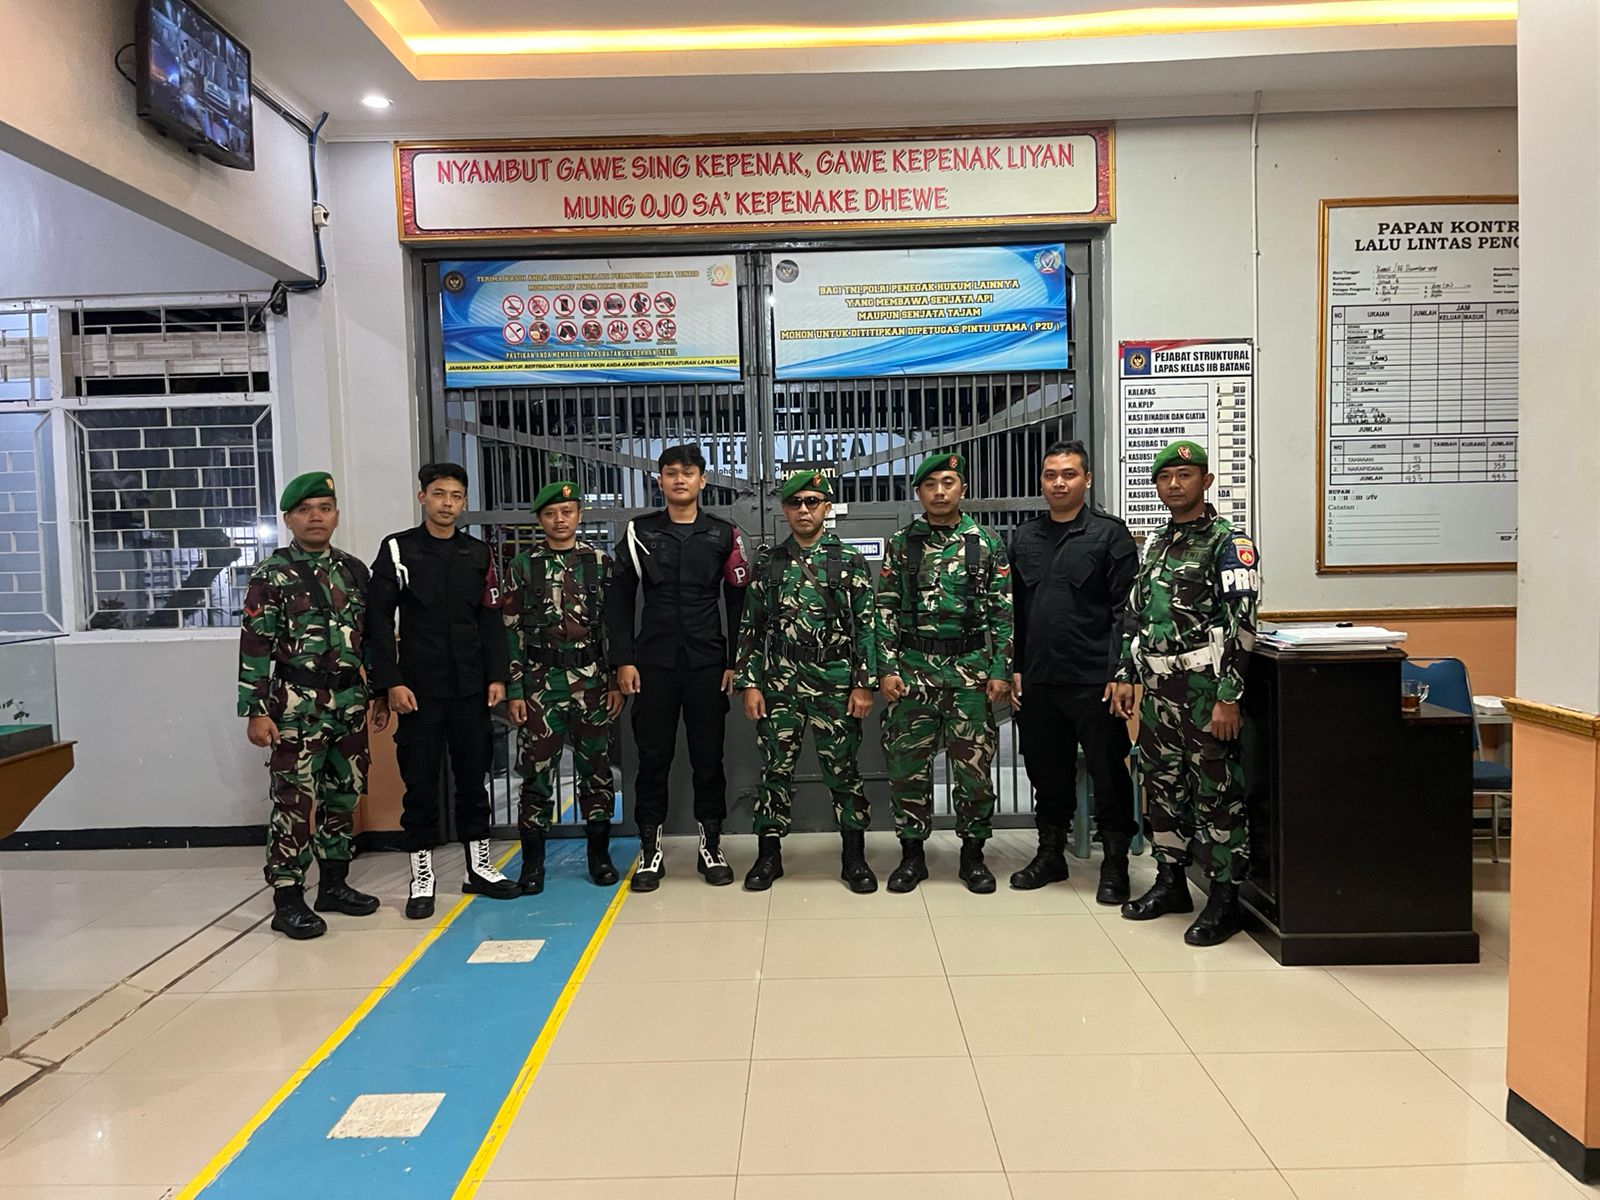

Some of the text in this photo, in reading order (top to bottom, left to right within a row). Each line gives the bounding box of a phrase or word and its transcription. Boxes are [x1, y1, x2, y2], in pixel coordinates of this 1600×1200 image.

[437, 143, 1075, 184] NYAMBUT GAWE SING KEPENAK, GAWE KEPENAK LIYAN
[563, 194, 636, 219] MUNG
[640, 191, 688, 218] OJO
[735, 188, 859, 214] KEPENAKE
[864, 186, 950, 213] DHEWE
[1378, 222, 1443, 235] PAPAN
[1355, 238, 1401, 251] LALU
[1407, 237, 1472, 250] LINTAS
[819, 286, 842, 296] BAGI
[891, 282, 936, 294] PENEGAK
[937, 281, 972, 291] HUKUM
[973, 279, 1020, 290] LAINNYA
[845, 294, 993, 308] YANG MEMBAWA SENJATA API
[858, 307, 982, 321] MAUPUN SENJATA TAJAM
[780, 330, 815, 340] MOHON
[815, 328, 849, 339] UNTUK
[850, 326, 906, 337] DITITIPKAN
[907, 324, 959, 336] DIPETUGAS
[961, 323, 990, 333] PINTU
[992, 322, 1027, 332] UTAMA
[1035, 321, 1054, 331] P2U
[1155, 350, 1249, 362] PEJABAT STRUKTURAL
[1155, 362, 1250, 373] LAPAS KELAS IIB BATANG
[1128, 388, 1156, 396] KALAPAS
[1144, 413, 1170, 421] BINADIK
[1128, 426, 1185, 435] KASI ADM KAMTIB
[792, 437, 867, 462] AREA
[1128, 439, 1168, 448] KASUBAG TU
[1128, 453, 1152, 461] KASUBSI
[1128, 504, 1156, 512] KASUBSI
[734, 567, 746, 584] P
[1221, 568, 1258, 593] PRO
[490, 587, 500, 604] P
